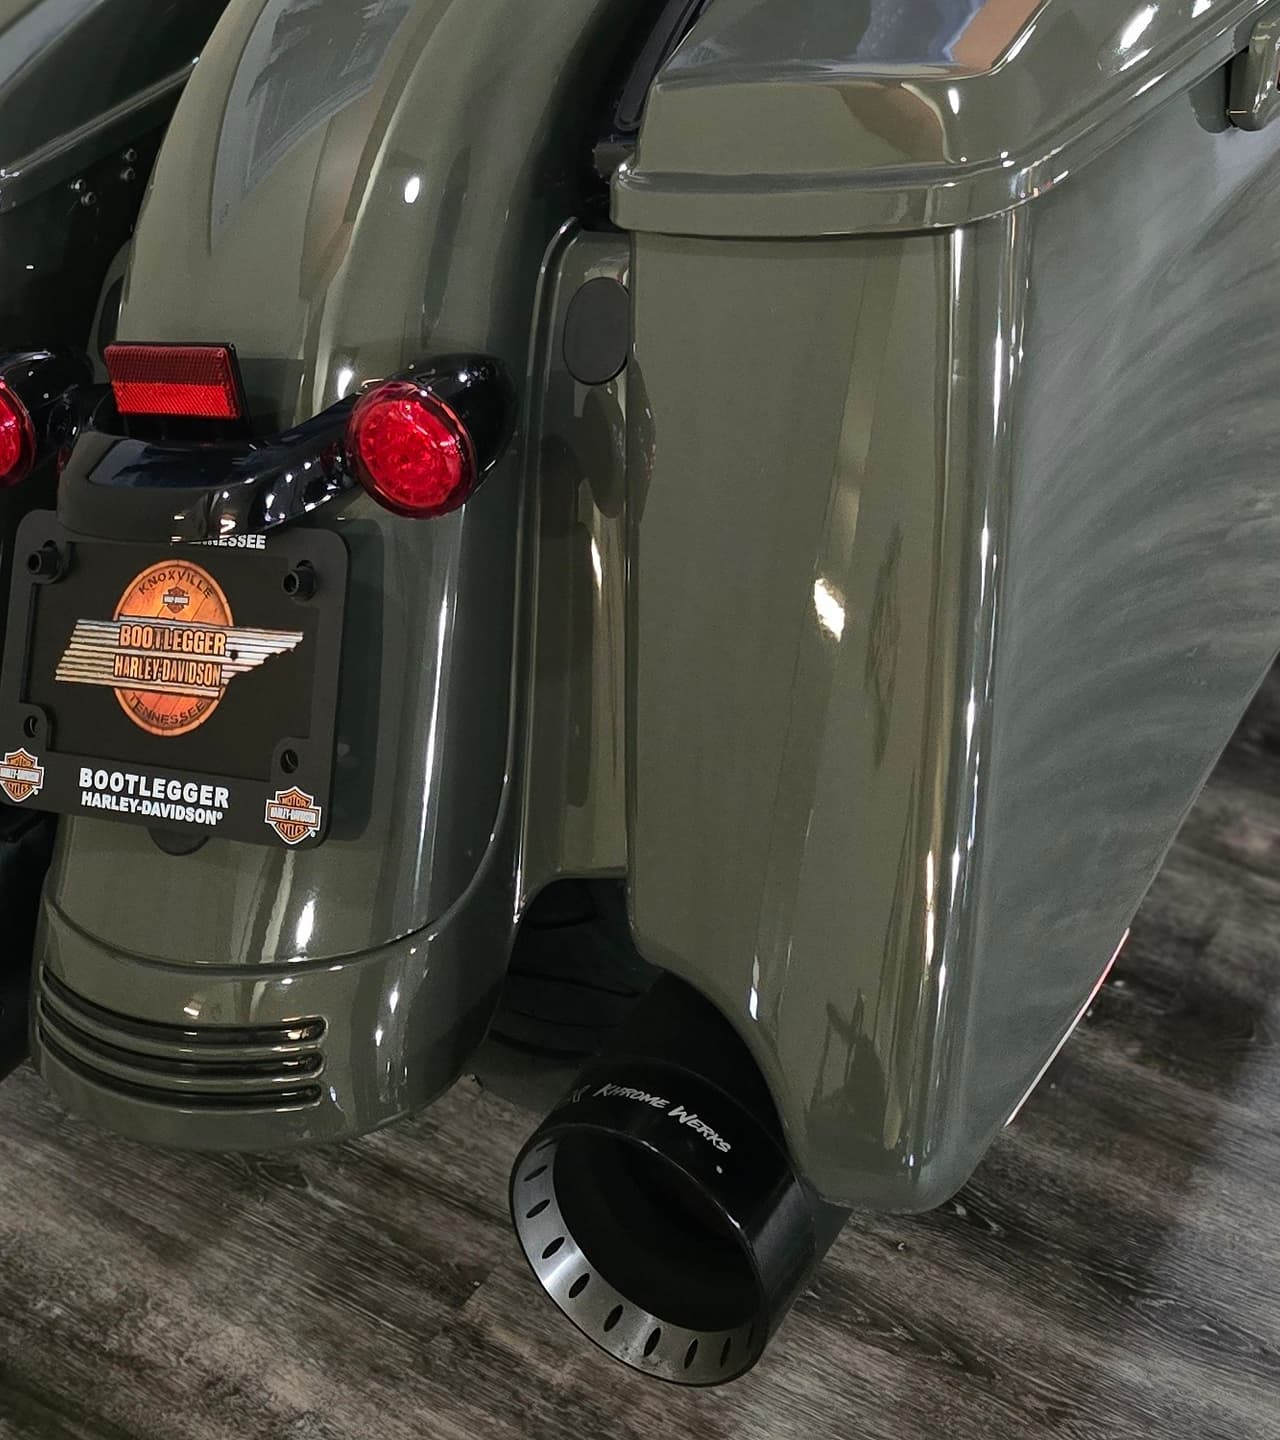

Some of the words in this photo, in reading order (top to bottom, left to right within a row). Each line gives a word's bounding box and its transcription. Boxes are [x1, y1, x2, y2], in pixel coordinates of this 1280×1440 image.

[137, 568, 214, 599] KNOXVILLE
[120, 624, 227, 657] BOOTLEGGER
[114, 655, 222, 687] HARLEY-DAVIDSON
[129, 691, 207, 727] TENNESSEE
[79, 767, 230, 809] BOOTLEGGER
[667, 1105, 732, 1153] WERKS
